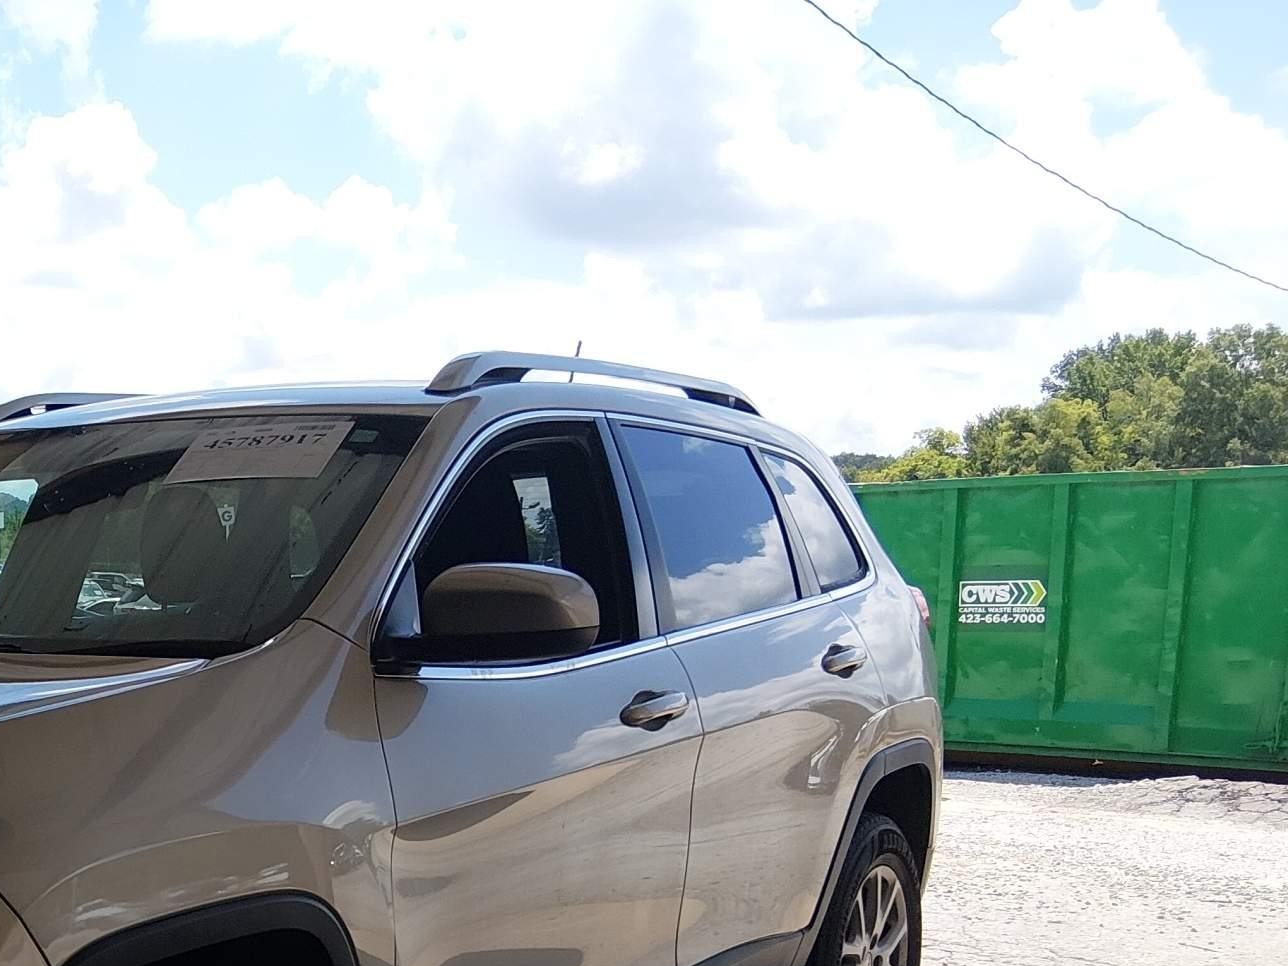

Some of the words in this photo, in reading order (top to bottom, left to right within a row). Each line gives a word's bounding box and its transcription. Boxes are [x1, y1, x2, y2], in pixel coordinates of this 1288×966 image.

[203, 433, 328, 450] 45787917
[221, 510, 233, 522] G
[961, 584, 1011, 604] CWS
[958, 613, 1045, 624] 423-664-7000
